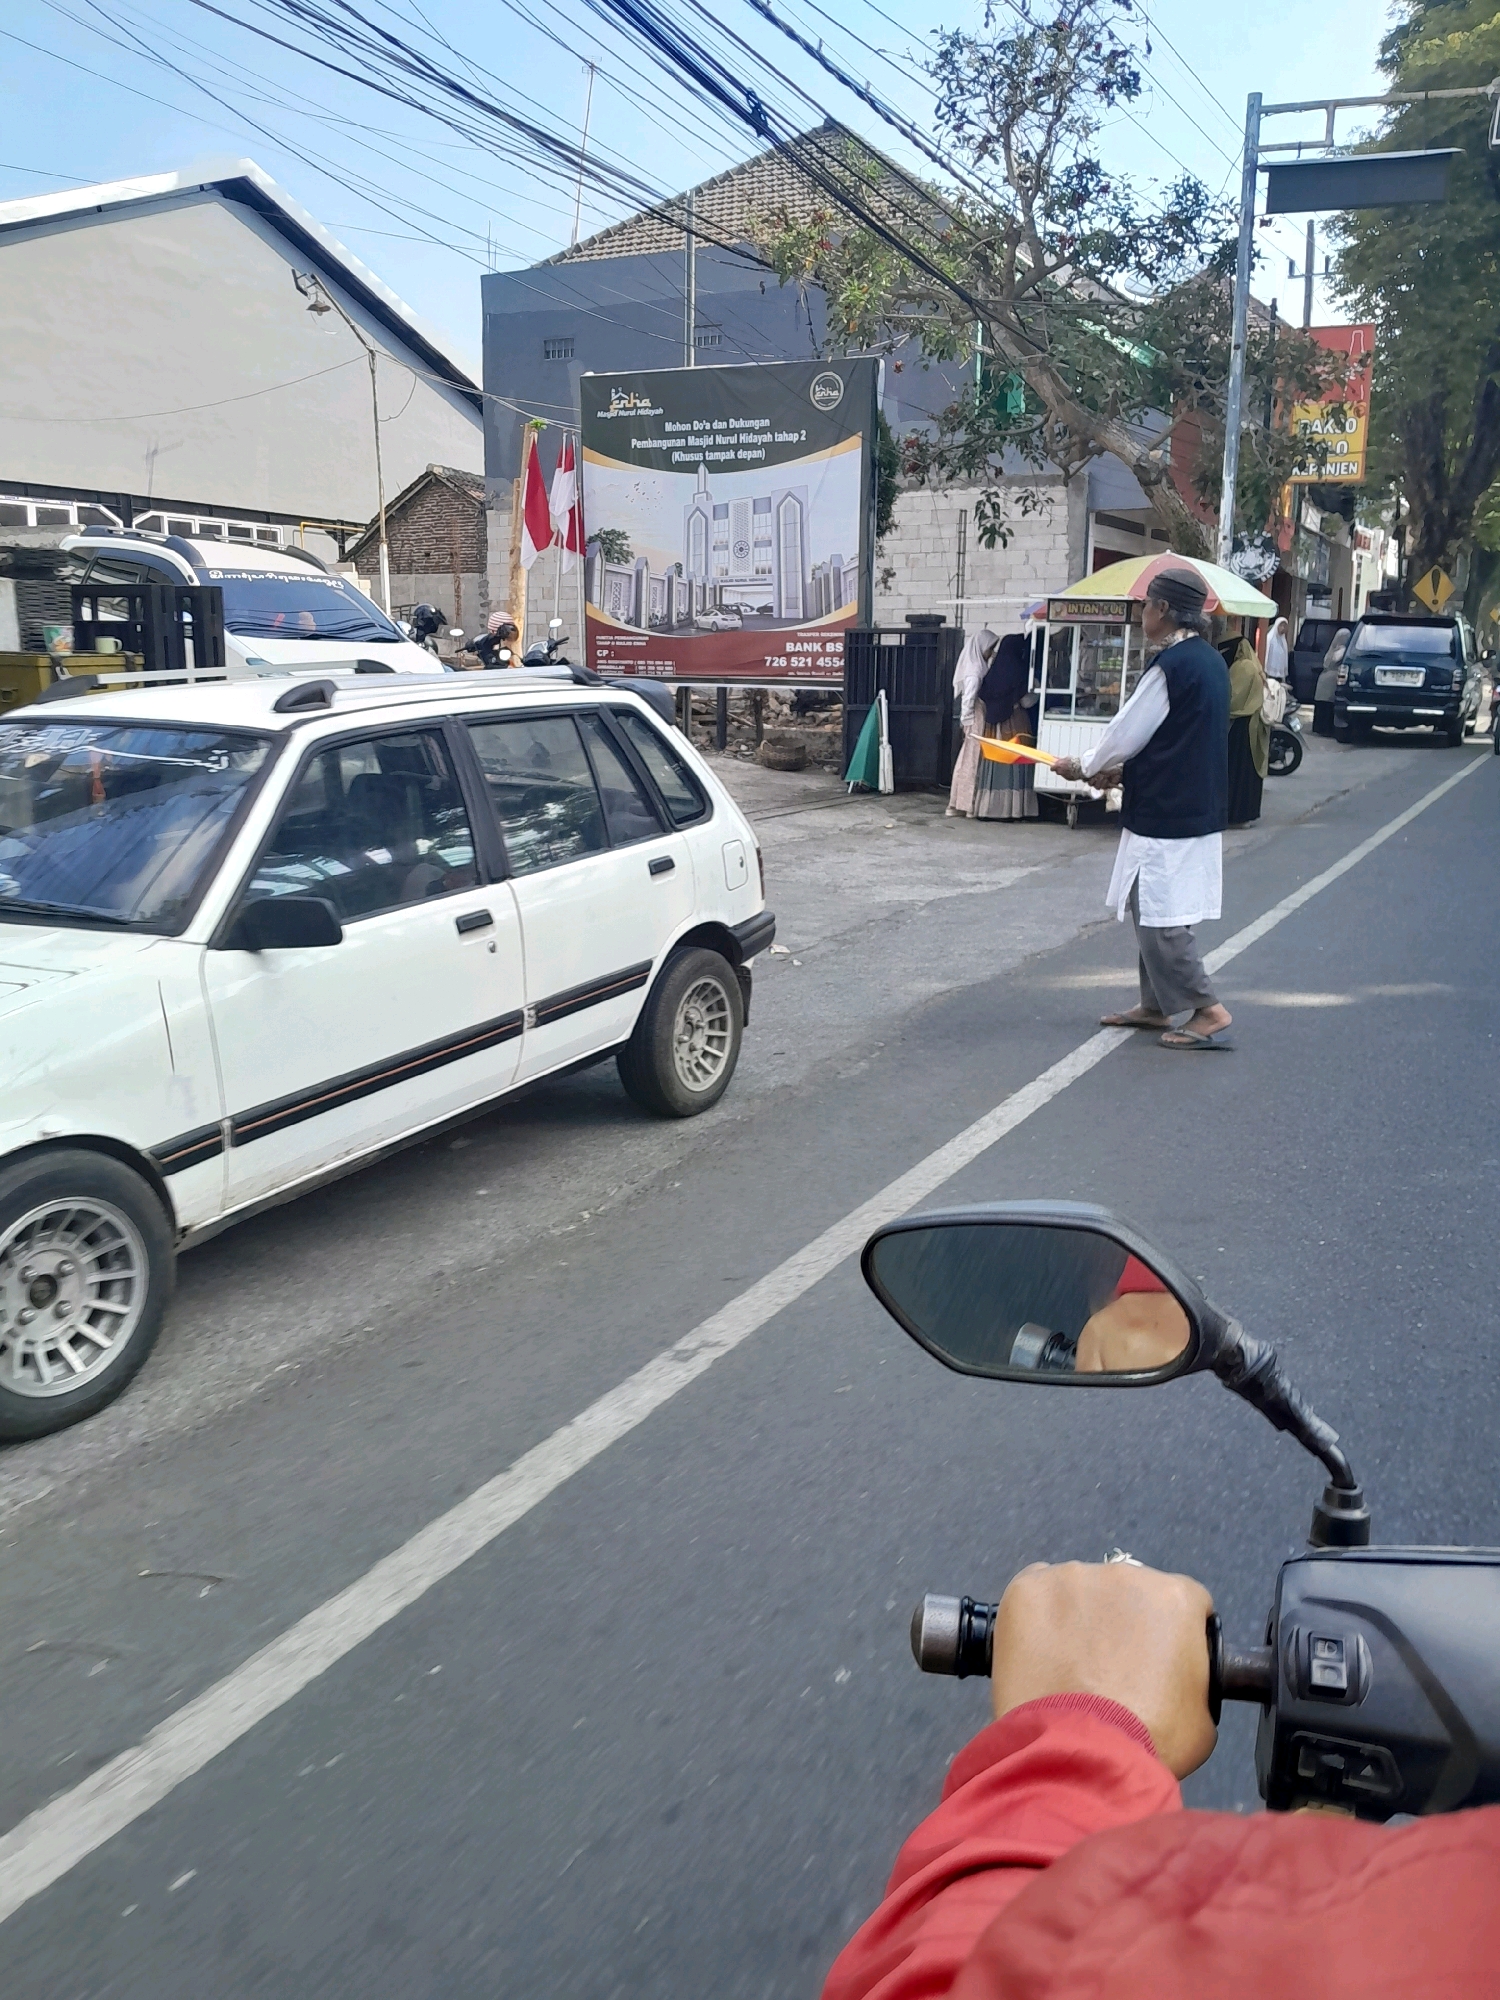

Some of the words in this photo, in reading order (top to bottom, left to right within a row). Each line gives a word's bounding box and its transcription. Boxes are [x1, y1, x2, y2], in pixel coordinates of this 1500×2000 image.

[597, 410, 617, 419] Masjid
[618, 408, 636, 417] Nurul
[637, 407, 664, 417] Hidayah
[665, 421, 691, 432] Mohon
[693, 420, 710, 431] Do'a
[712, 419, 727, 430] dan
[729, 418, 770, 430] Dukungan
[1300, 417, 1357, 434] BAKO
[631, 438, 686, 450] Pembangunan
[687, 435, 713, 448] Masjid
[715, 433, 738, 444] Nurul
[739, 432, 773, 445] Hidayah
[775, 431, 799, 443] tahap
[800, 429, 807, 441] 2
[671, 451, 703, 464] (Khusus
[705, 450, 735, 462] tampak
[737, 448, 766, 461] depan)
[1068, 603, 1099, 614] INTAN
[596, 649, 609, 657] CP
[785, 642, 823, 652] BANK
[764, 656, 787, 667] 726
[790, 656, 812, 667] 521
